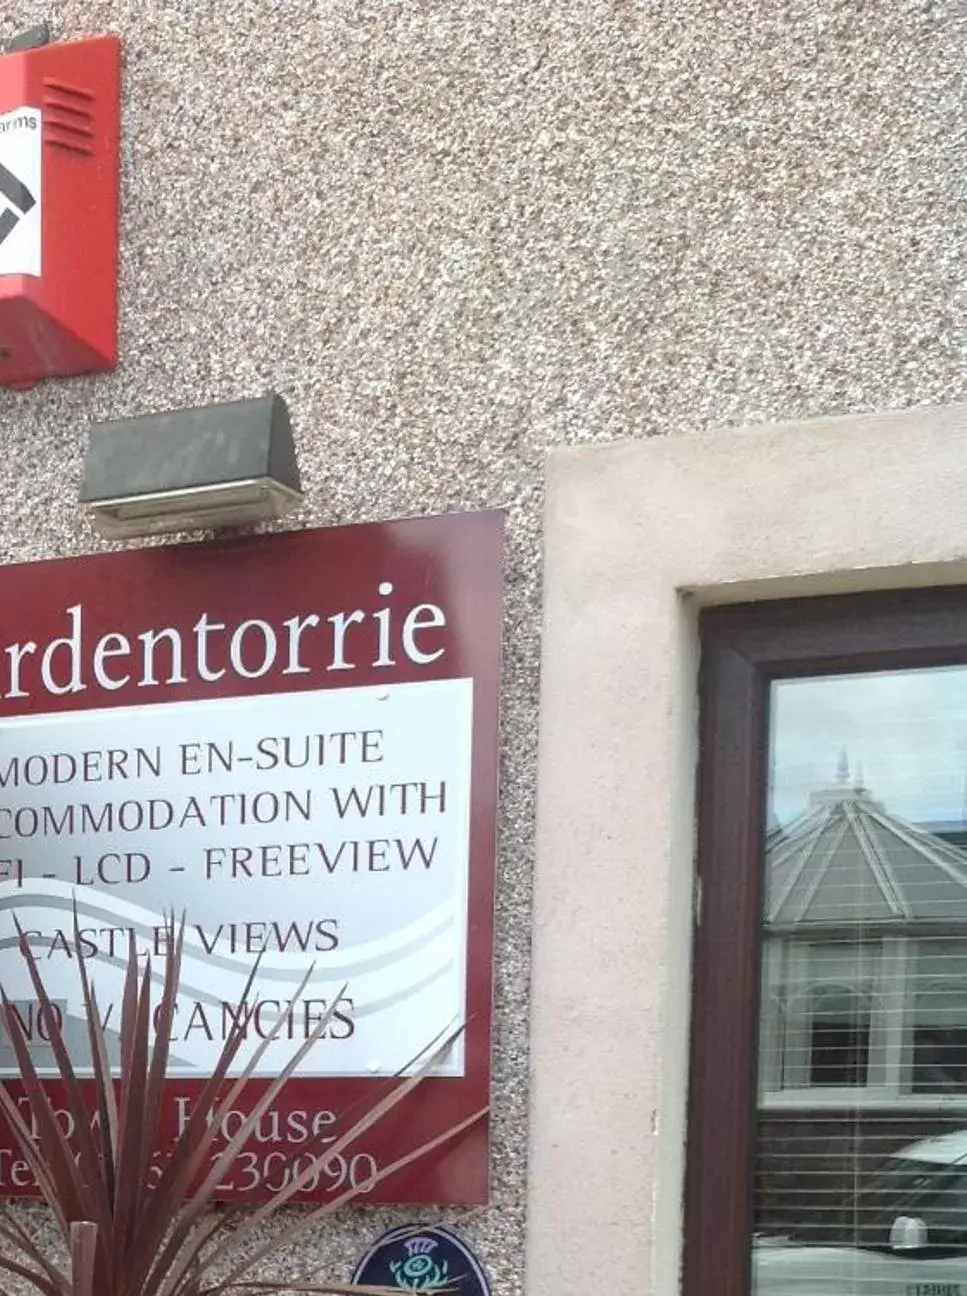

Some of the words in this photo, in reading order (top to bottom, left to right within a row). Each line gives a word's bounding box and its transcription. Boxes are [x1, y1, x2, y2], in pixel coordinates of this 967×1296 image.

[180, 729, 384, 777] EN-SUITE
[328, 780, 447, 822] WITH
[74, 853, 151, 886] LCD
[202, 836, 439, 881] FREEVIEW
[20, 927, 175, 960] CASTLE
[194, 918, 339, 954] VIEWS
[82, 998, 355, 1042] CANCIES
